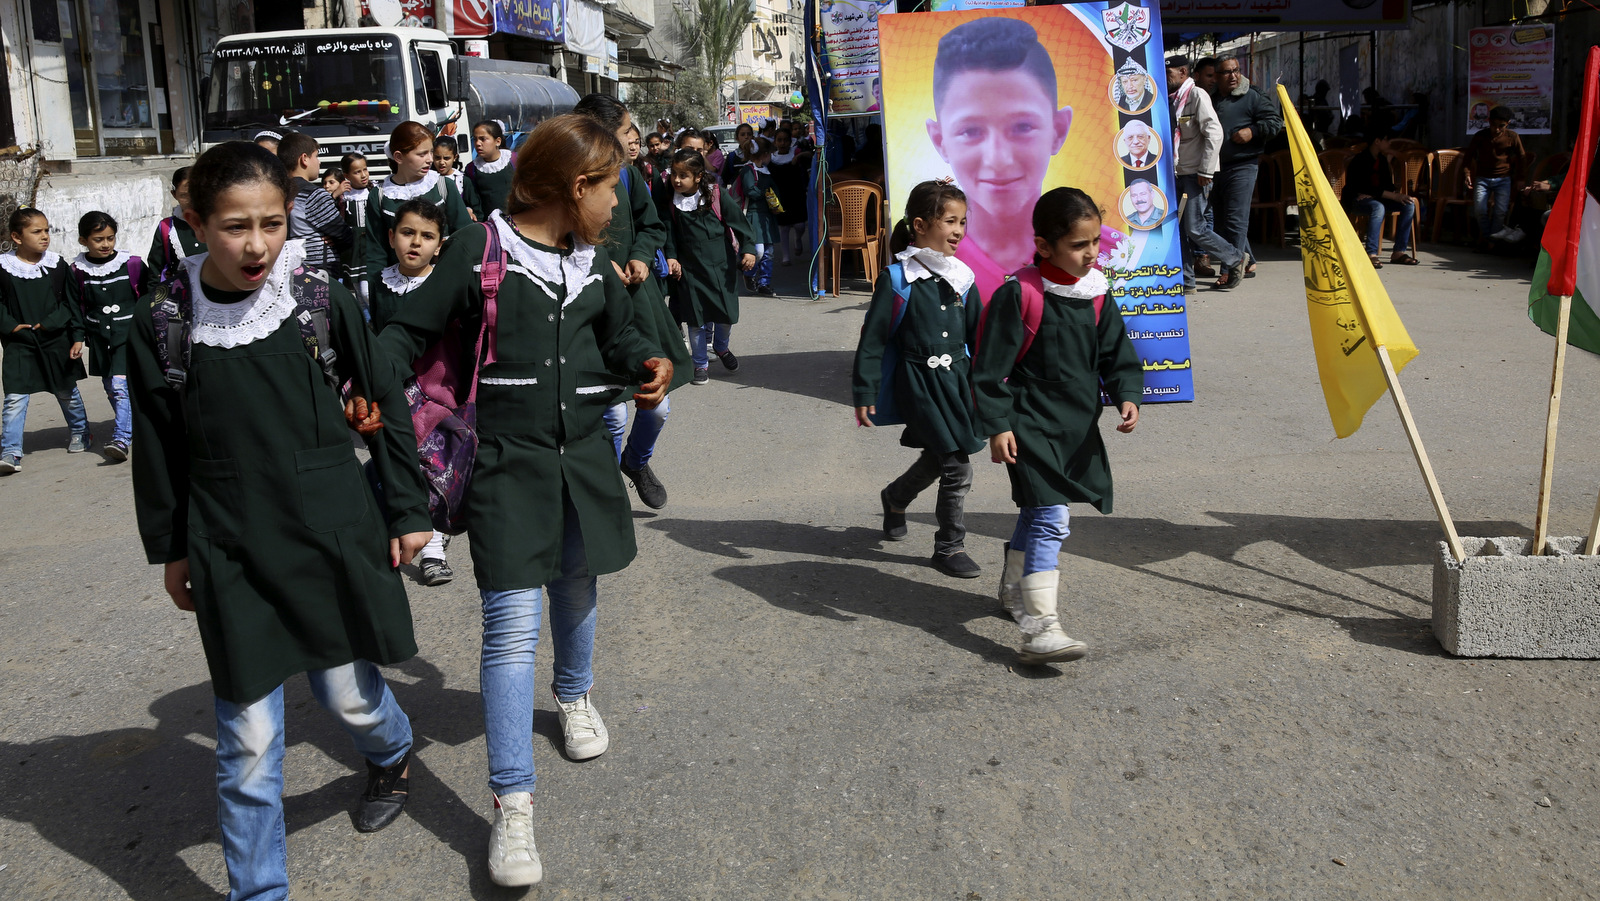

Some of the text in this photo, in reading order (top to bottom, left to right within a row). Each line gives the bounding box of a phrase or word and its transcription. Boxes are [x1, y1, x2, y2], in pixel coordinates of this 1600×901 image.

[844, 12, 864, 22] نعي شهيد
[316, 41, 348, 53] والزعيم
[349, 40, 373, 51] ياسين
[375, 40, 393, 50] مياه
[341, 143, 385, 153] DAF
[1113, 266, 1153, 281] التحرير
[1153, 265, 1181, 278] حركة
[1130, 287, 1144, 298] غزة
[1145, 285, 1164, 297] شمال
[1165, 284, 1185, 296] إقليم
[1142, 303, 1184, 315] منطقة
[1141, 331, 1154, 339] عند
[1155, 329, 1184, 340] تحتسب
[1142, 358, 1191, 371] محمد
[1153, 385, 1180, 396] نحسبه
